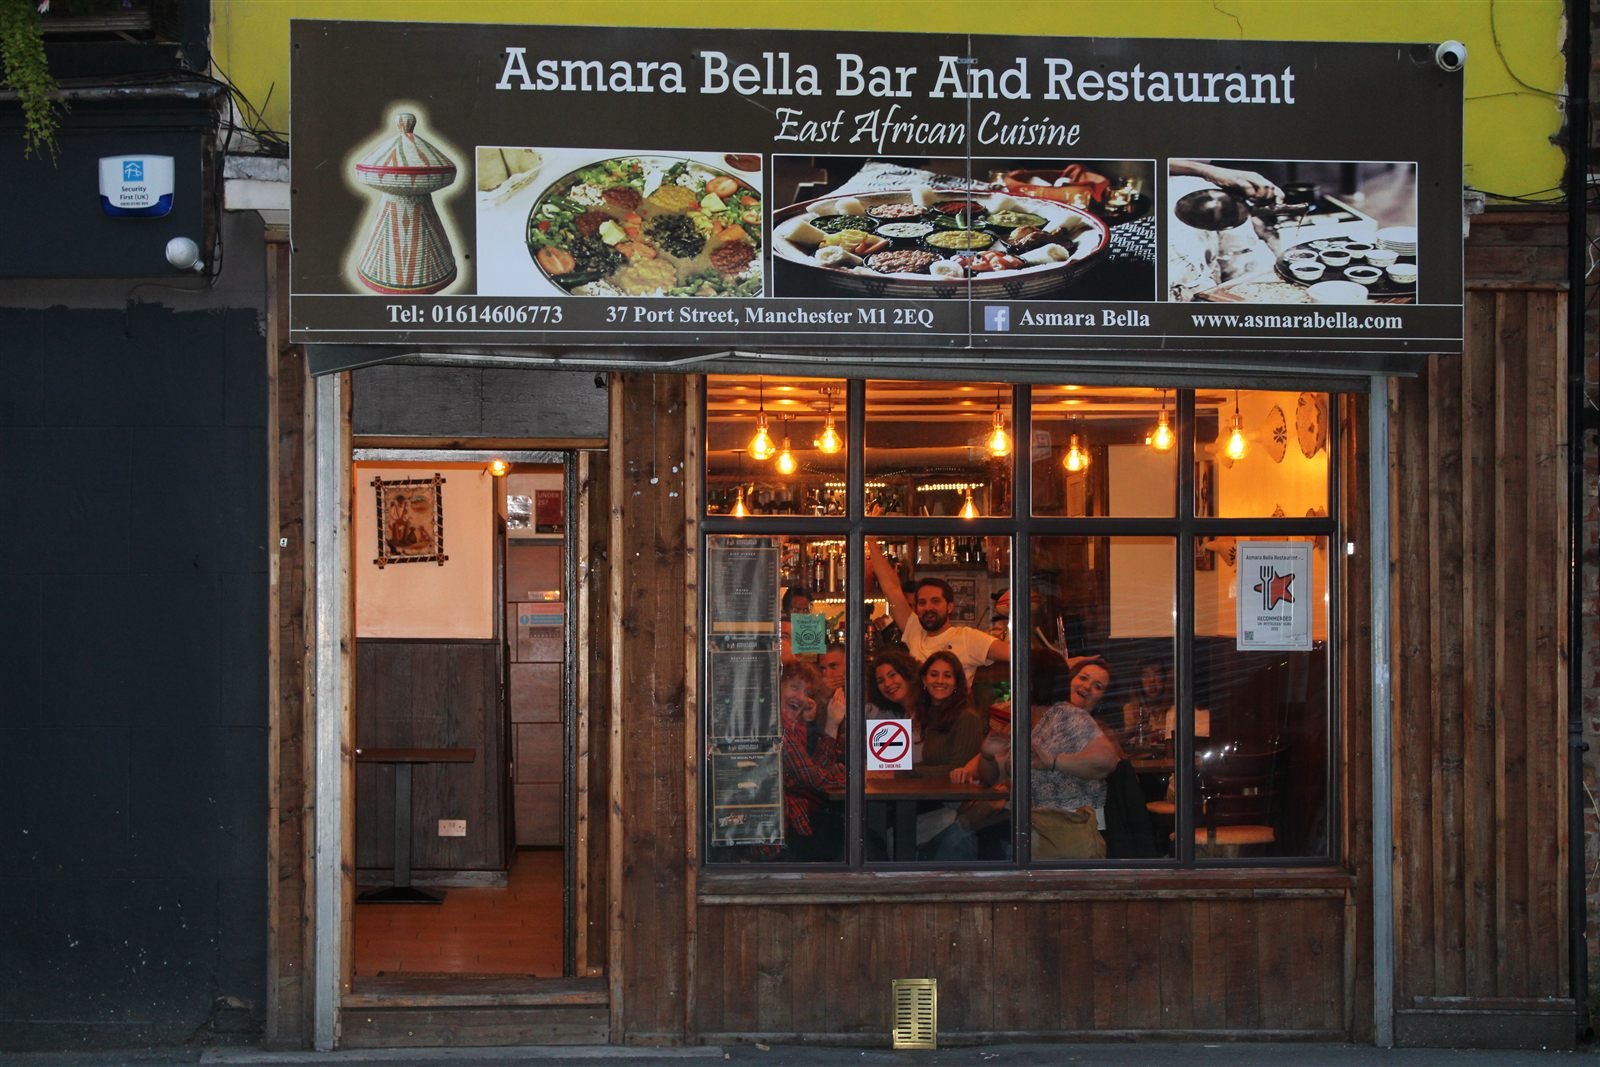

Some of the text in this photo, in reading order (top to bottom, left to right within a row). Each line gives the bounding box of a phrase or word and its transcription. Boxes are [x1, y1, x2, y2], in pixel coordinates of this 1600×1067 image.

[495, 47, 1295, 105] Asmara Bella Bar And Restaurant
[773, 104, 1081, 154] East African Cuisine
[386, 304, 563, 324] Tel: 01614606773
[606, 305, 934, 329] 37 Port Street, Manchester M1 2EQ
[1019, 308, 1150, 327] Asmara Bella
[1191, 311, 1403, 329] www.asmarabella.com
